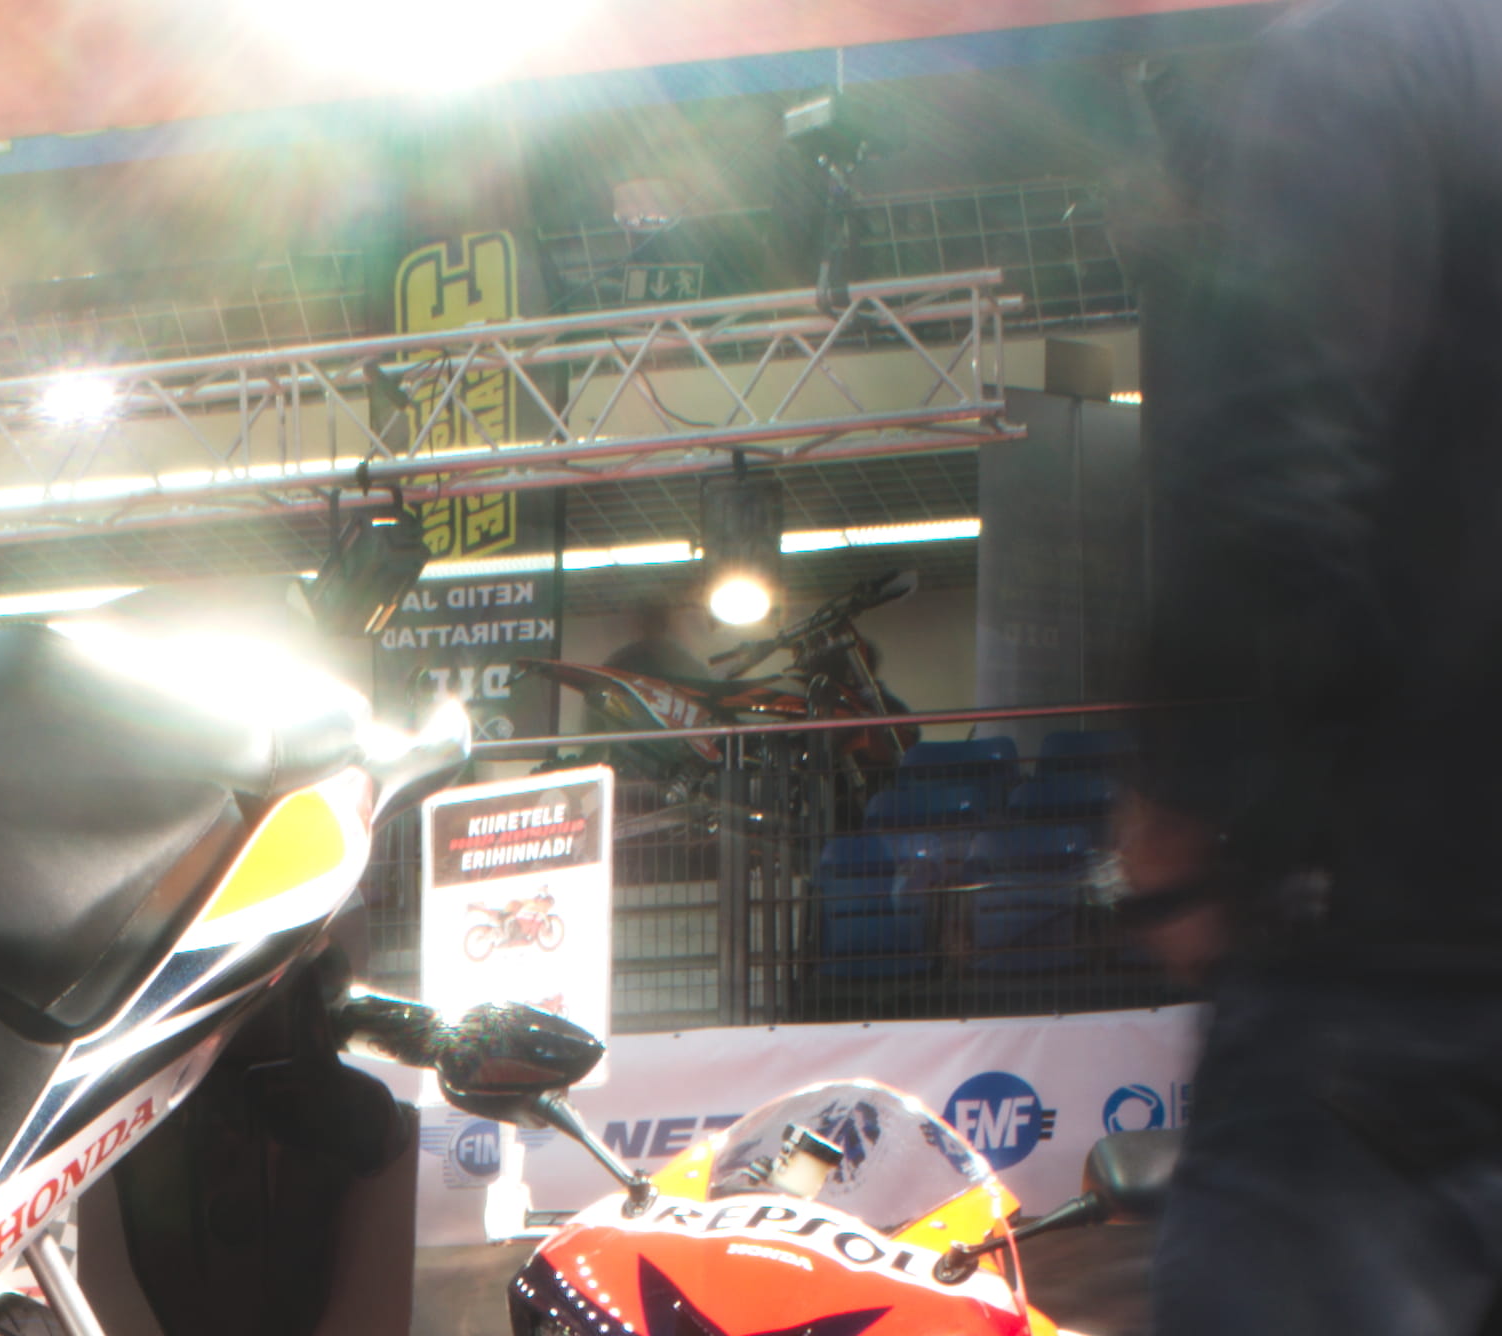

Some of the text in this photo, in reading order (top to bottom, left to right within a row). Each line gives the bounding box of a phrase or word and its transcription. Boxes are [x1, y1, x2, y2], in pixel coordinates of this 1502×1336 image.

[467, 803, 567, 838] KIIRETELE
[460, 835, 574, 872] ERIHINNAD!
[654, 1205, 918, 1276] REPSOL
[727, 1243, 814, 1272] HONDA
